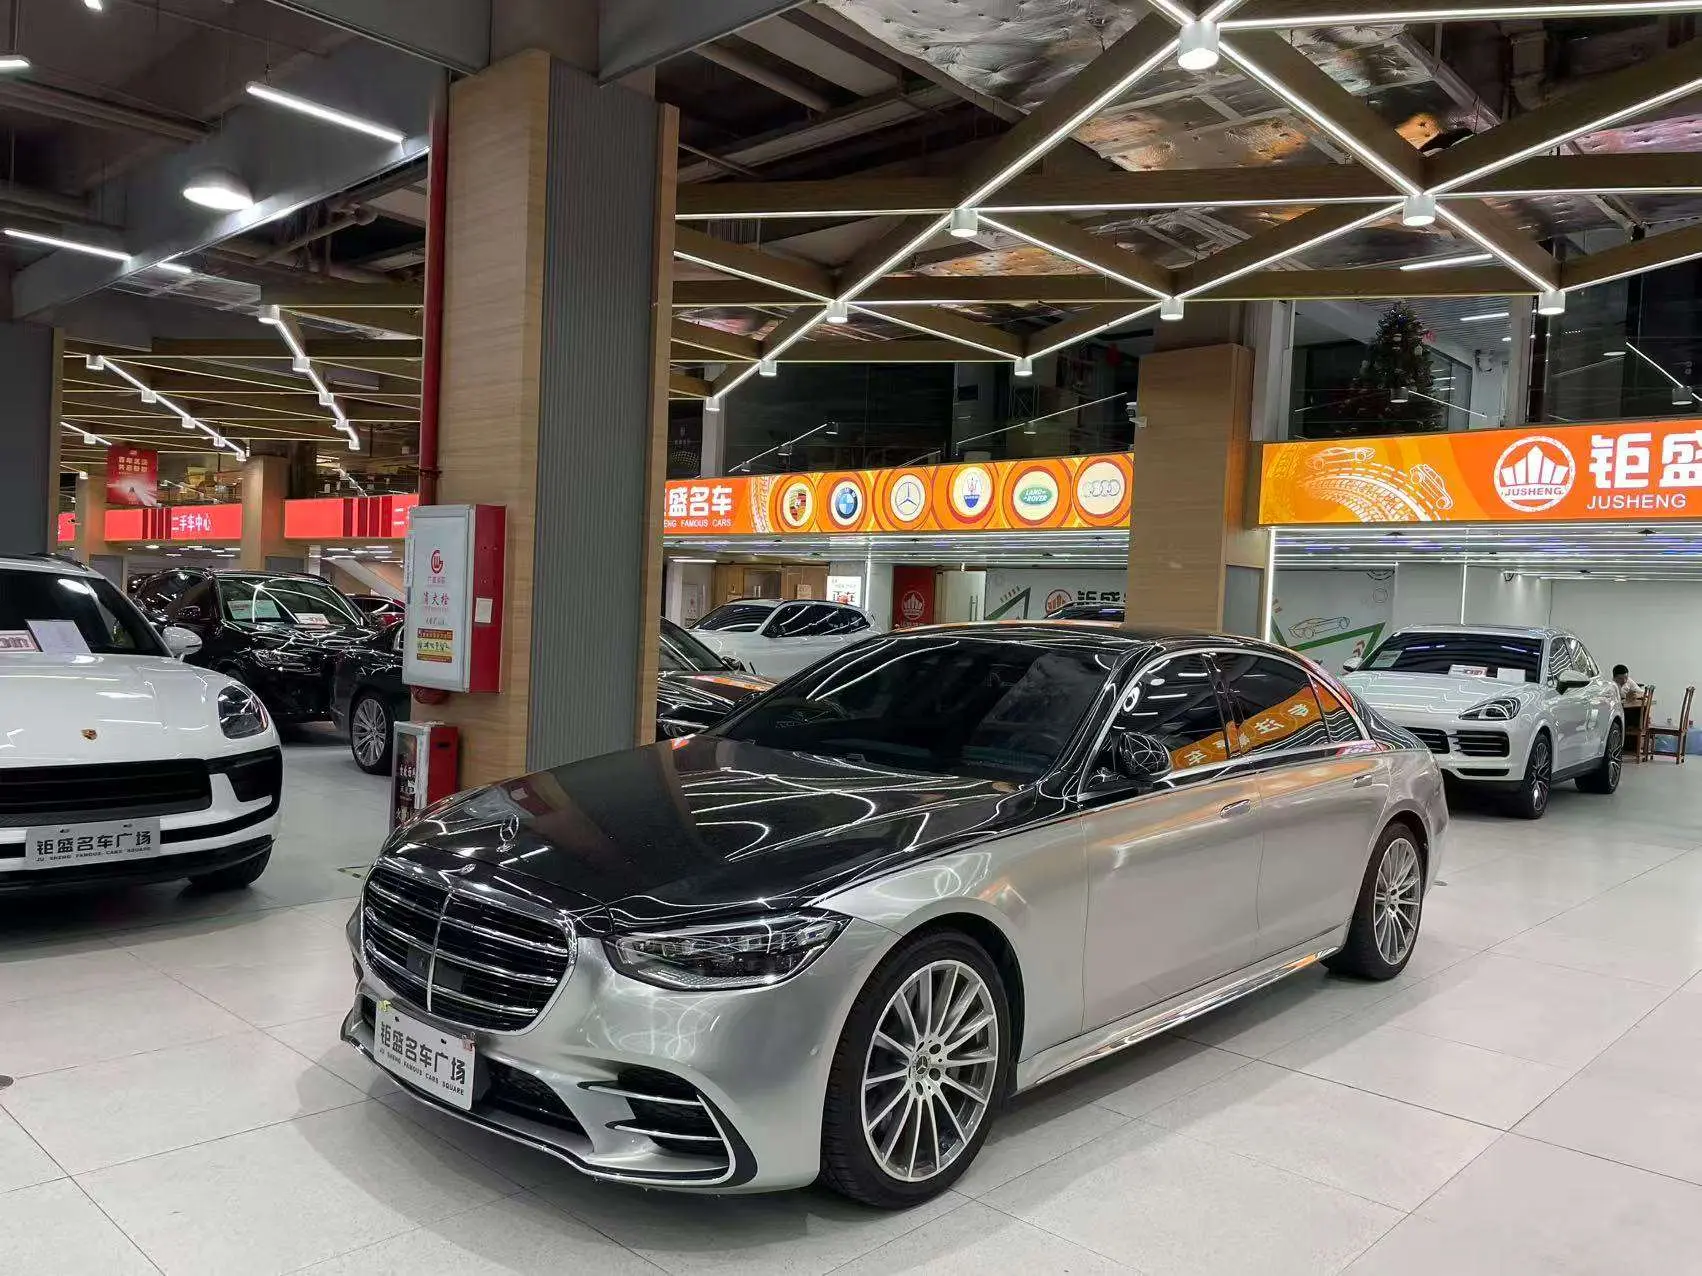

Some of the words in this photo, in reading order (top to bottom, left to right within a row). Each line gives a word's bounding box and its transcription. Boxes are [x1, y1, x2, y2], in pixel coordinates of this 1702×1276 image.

[664, 485, 733, 516] 盛名车
[1504, 487, 1562, 497] JUSHENG
[1586, 493, 1687, 510] JUSHENG
[171, 512, 212, 531] 二手车中心
[681, 519, 709, 528] FAMOUS
[712, 518, 732, 527] CARS
[37, 831, 151, 855] 钜盛名车广场
[380, 1020, 466, 1084] 钜盛名车广场
[425, 1073, 439, 1084] CARS
[442, 1081, 464, 1096] SQUARE
